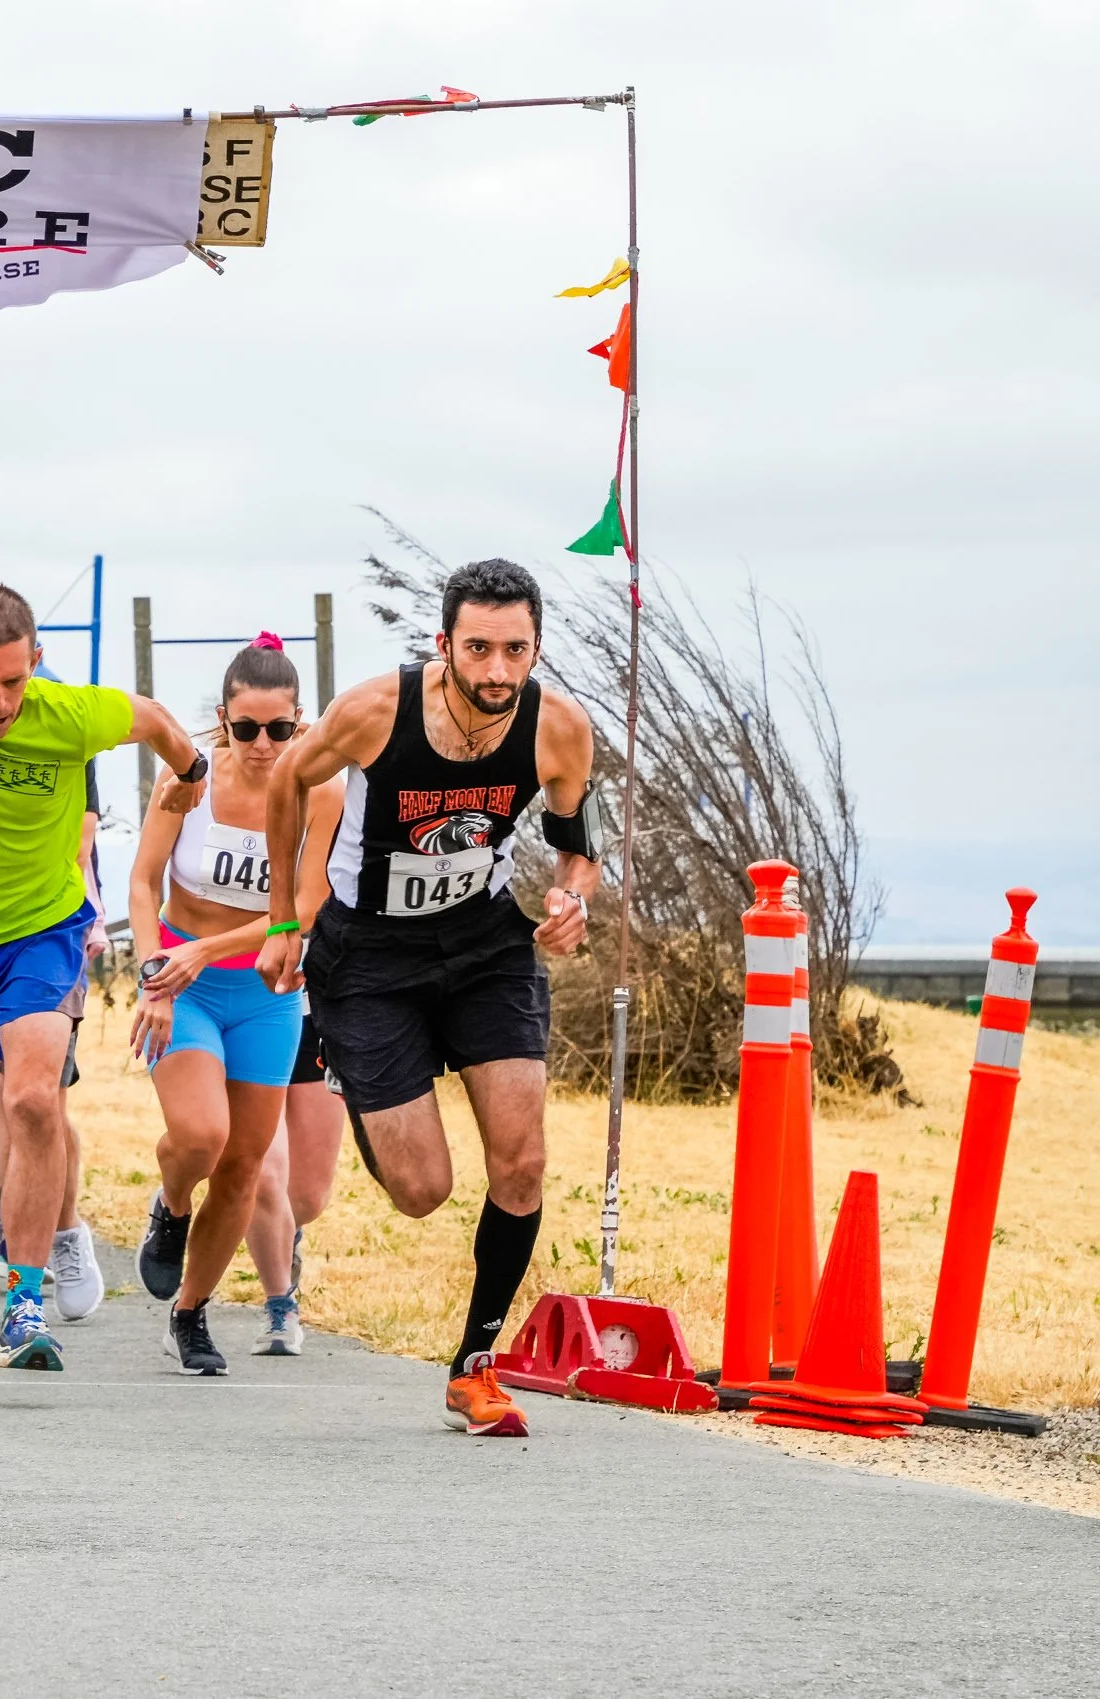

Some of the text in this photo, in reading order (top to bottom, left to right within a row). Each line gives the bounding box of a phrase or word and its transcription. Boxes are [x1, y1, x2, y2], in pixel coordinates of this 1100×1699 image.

[399, 785, 516, 822] HALF MOON BAY
[213, 851, 270, 893] 048
[404, 871, 475, 910] 043
